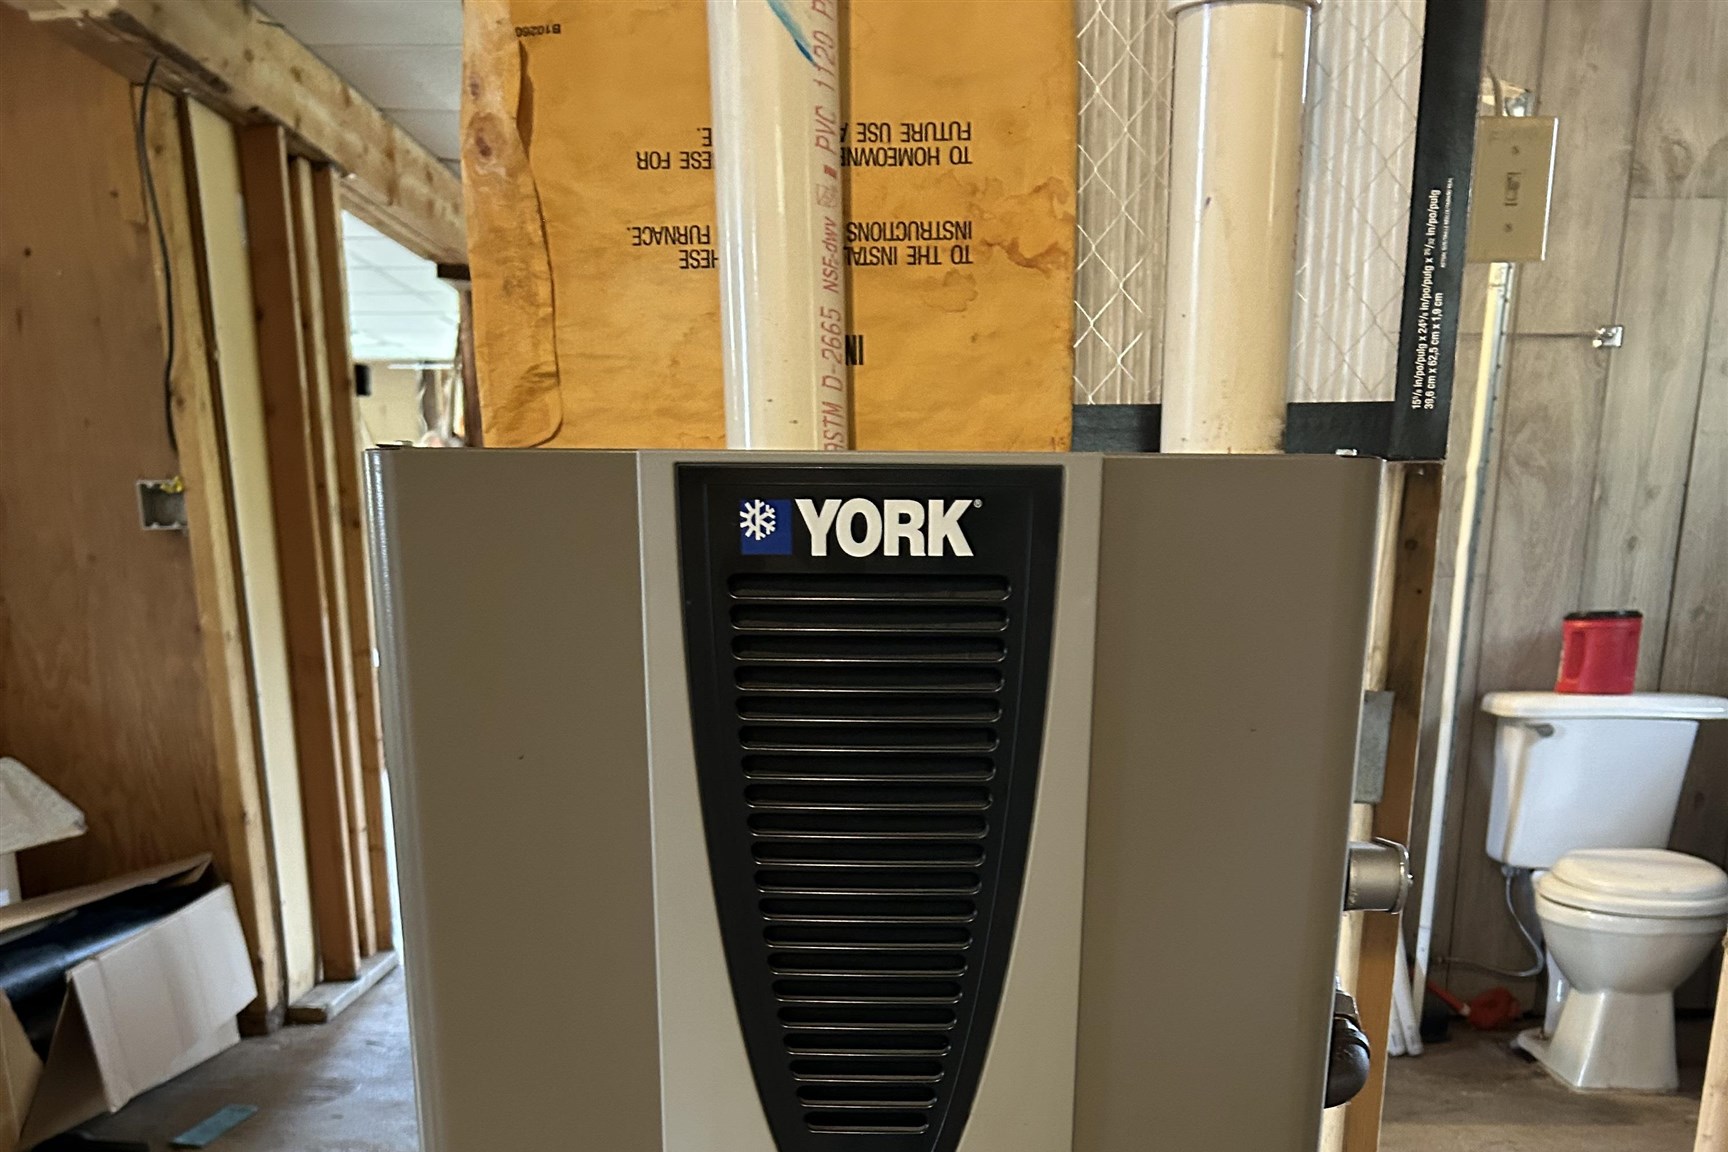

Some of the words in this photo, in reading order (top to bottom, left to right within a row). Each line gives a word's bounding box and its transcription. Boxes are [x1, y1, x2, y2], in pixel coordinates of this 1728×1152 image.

[813, 30, 836, 91] 1120
[815, 105, 837, 154] PVC
[857, 122, 891, 143] USE
[900, 121, 971, 143] FUTURE
[636, 151, 670, 170] FOR
[680, 151, 713, 169] ESE
[841, 147, 940, 167] HOMEOWNE
[950, 146, 973, 165] TO
[627, 225, 710, 246] FURNACE.
[846, 221, 972, 242] INSTRUCTIONS
[679, 249, 718, 269] HESE
[844, 246, 897, 266] INSTAL
[907, 246, 942, 265] THE
[951, 245, 973, 264] TO
[1434, 292, 1443, 307] cm
[1431, 331, 1440, 345] cm
[820, 306, 843, 392] D-2665
[1427, 375, 1436, 389] cm
[822, 401, 844, 450] ASTM
[795, 498, 974, 557] YORK
